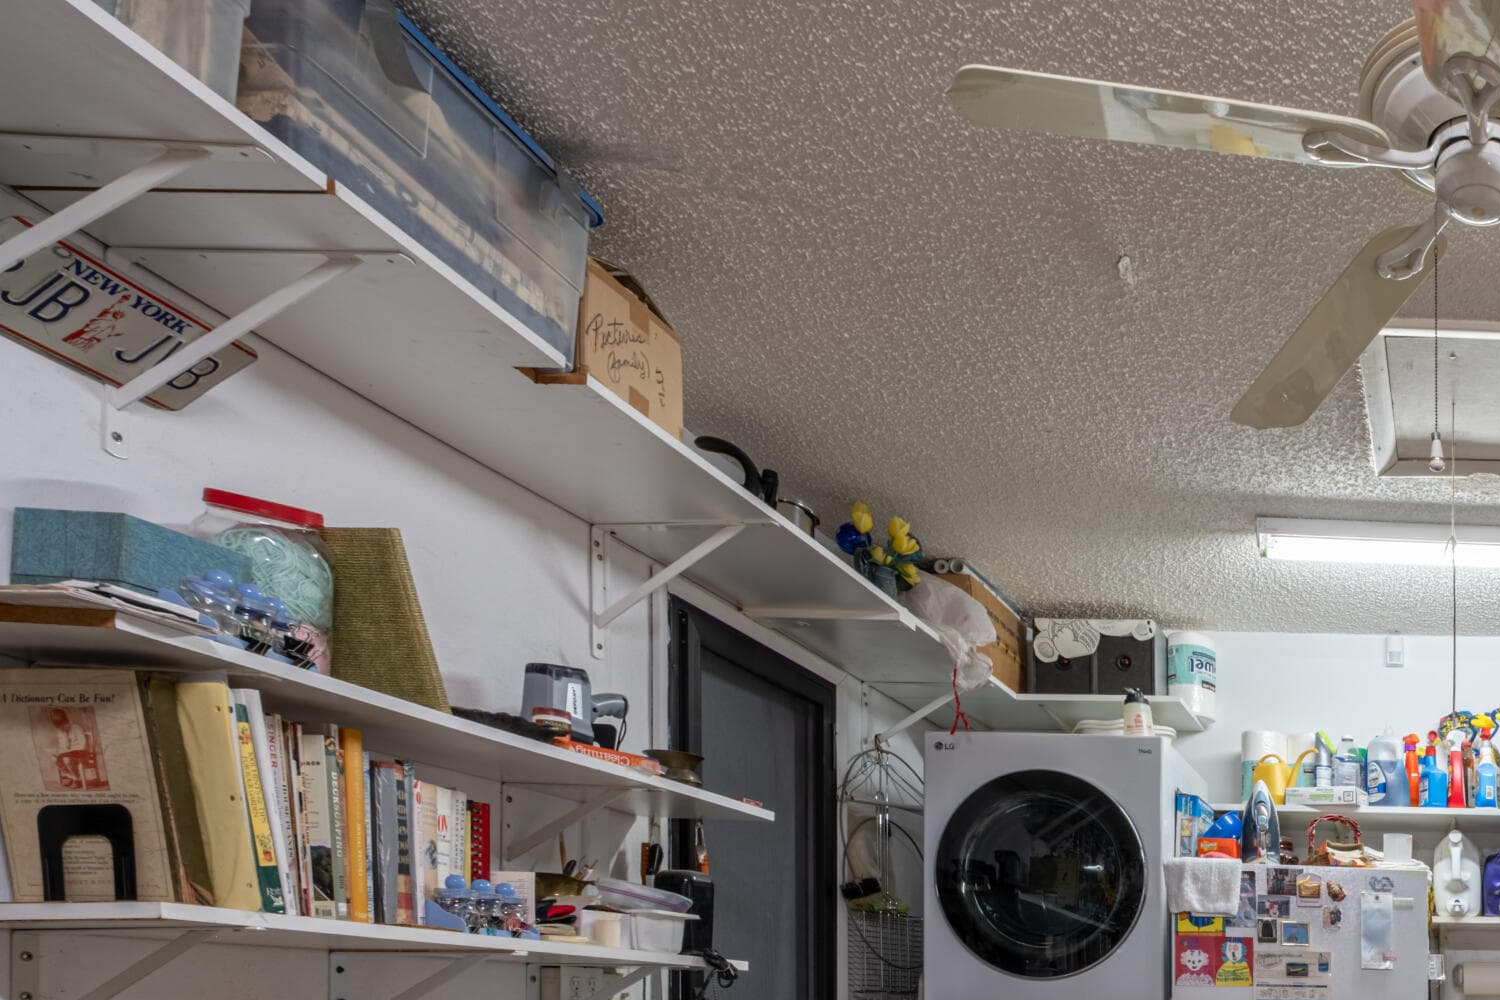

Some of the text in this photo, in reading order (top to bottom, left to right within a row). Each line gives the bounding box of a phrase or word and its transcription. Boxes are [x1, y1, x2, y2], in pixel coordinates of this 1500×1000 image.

[0, 259, 91, 324] JB
[65, 259, 194, 335] NEW YORK
[1190, 658, 1216, 673] wel
[11, 693, 54, 705] Dictionary
[57, 694, 76, 703] Can
[79, 693, 91, 702] Be
[94, 693, 115, 703] Fun!
[267, 723, 279, 769] SINGER
[575, 745, 631, 767] Cleaning
[331, 771, 345, 858] DECKSCAPING
